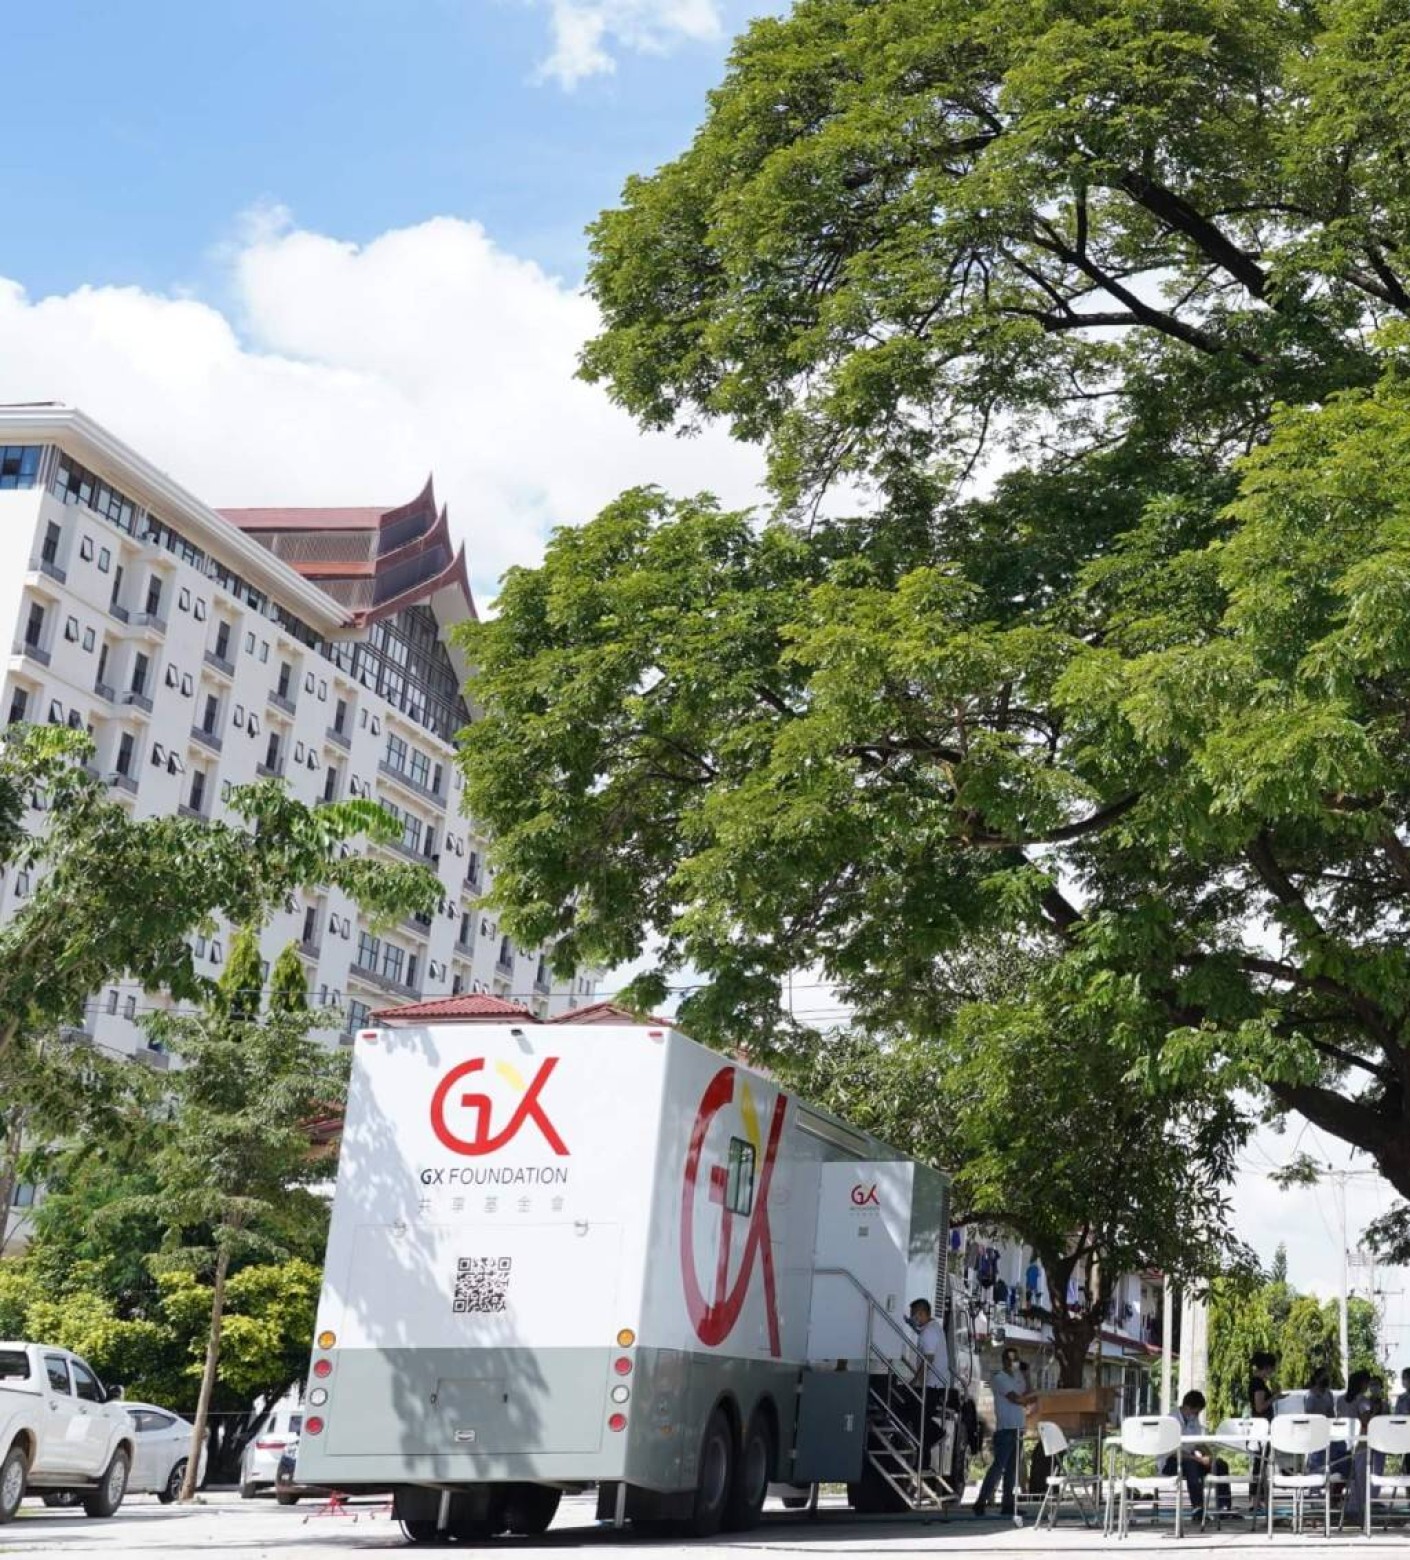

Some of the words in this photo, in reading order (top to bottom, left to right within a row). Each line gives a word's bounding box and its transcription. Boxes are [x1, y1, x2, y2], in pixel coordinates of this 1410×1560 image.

[431, 1057, 571, 1156] GX
[420, 1168, 445, 1185] GX
[449, 1167, 568, 1185] FOUNDATION
[850, 1183, 881, 1206] GX
[680, 1066, 788, 1358] GX
